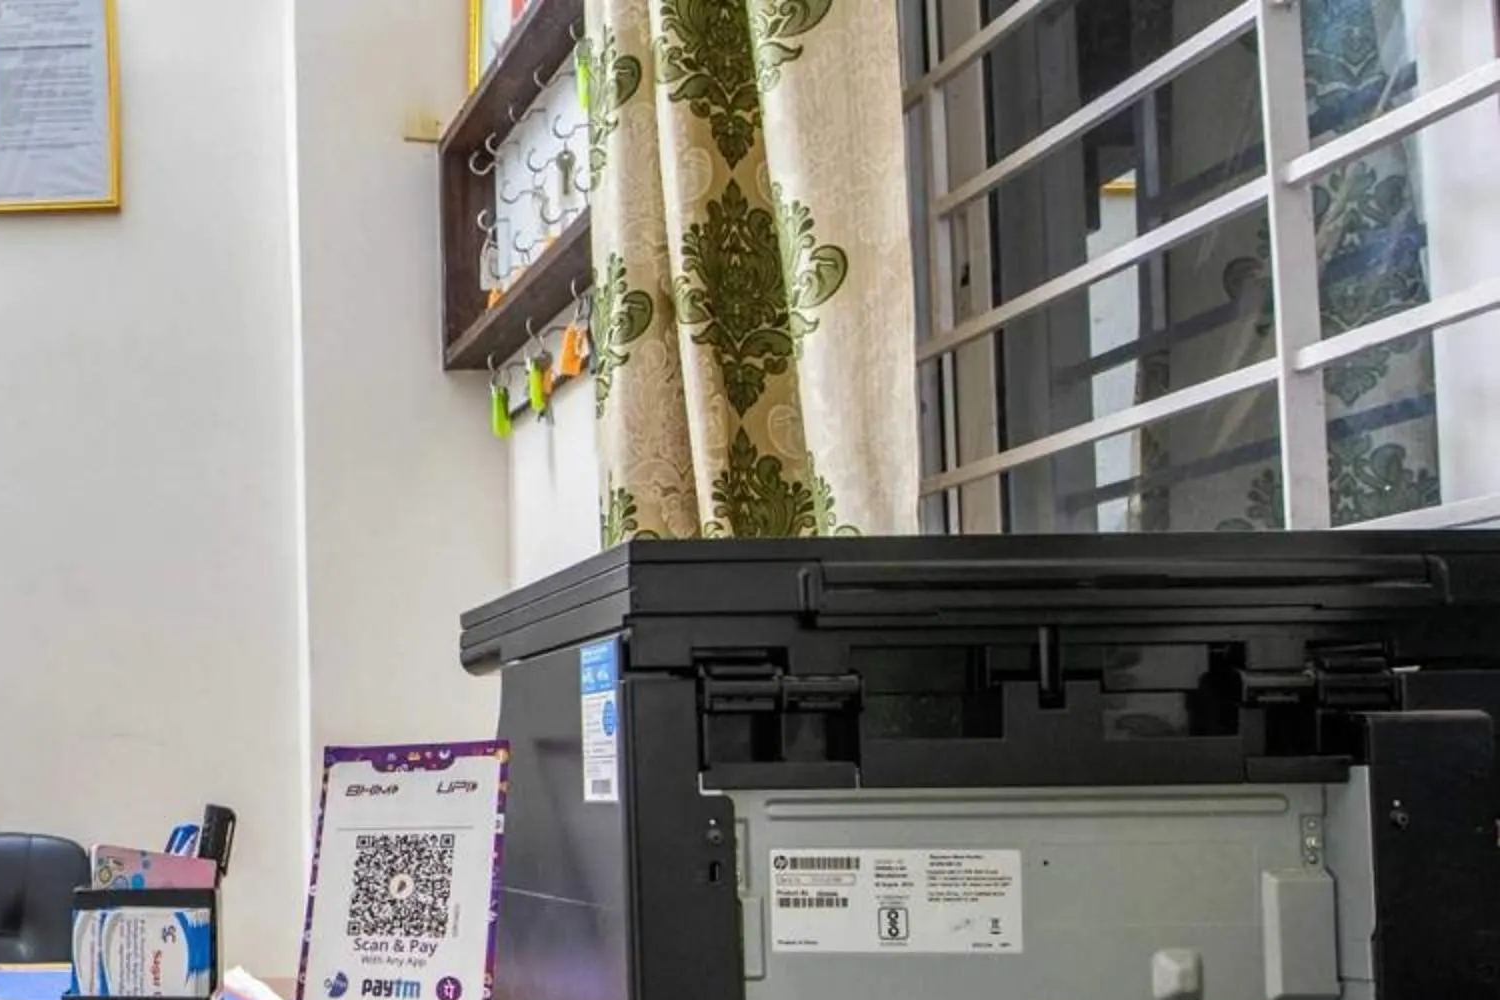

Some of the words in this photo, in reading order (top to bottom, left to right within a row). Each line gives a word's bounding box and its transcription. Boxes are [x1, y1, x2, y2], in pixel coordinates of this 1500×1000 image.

[354, 938, 389, 953] Scan
[393, 940, 405, 953] &
[410, 940, 439, 957] Pay
[386, 956, 404, 967] Any
[407, 957, 428, 969] App
